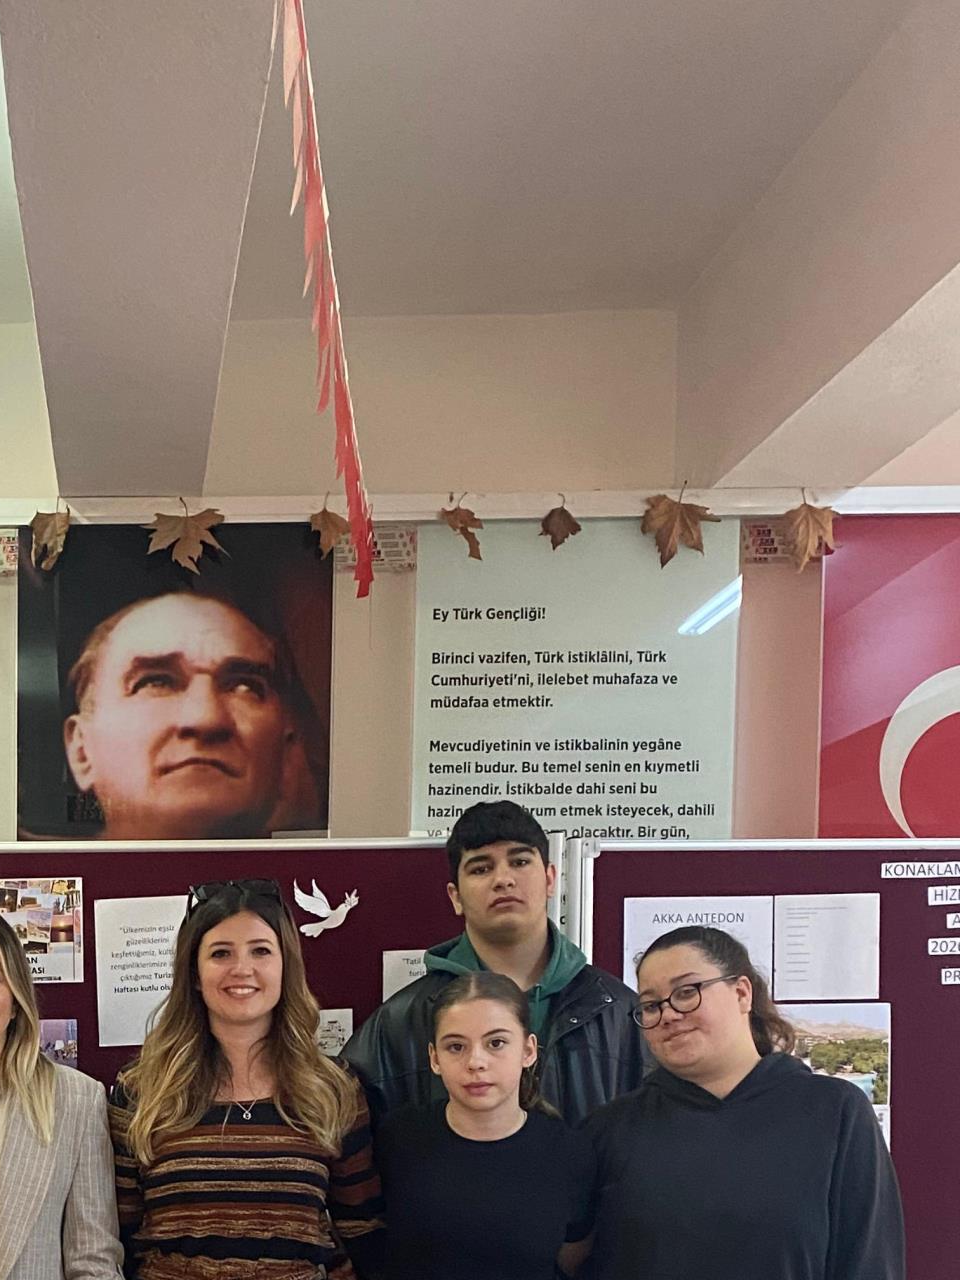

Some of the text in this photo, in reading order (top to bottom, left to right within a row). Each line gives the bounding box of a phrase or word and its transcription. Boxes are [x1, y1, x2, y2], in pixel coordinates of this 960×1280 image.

[433, 607, 546, 622] Ey Türk Gençliği!
[432, 651, 474, 664] Birinci
[478, 651, 531, 666] vazifen,
[534, 651, 564, 664] Türk
[636, 650, 666, 663] Türk
[538, 672, 589, 686] ilelebet
[592, 672, 658, 685] muhafaza
[662, 675, 678, 684] ve
[430, 695, 553, 708] müdafaa etmektir.
[429, 738, 682, 754] Mevcudiyetinin ve istikbalinin yegâne
[428, 760, 699, 774] temeli budur. Bu temel senin en kıymetli
[428, 780, 657, 796] hazinendir. İstikbalde dahi seni bu
[560, 804, 714, 818] etmek isteyecek, dahili
[638, 825, 657, 838] Bir
[660, 826, 690, 840] gün,
[934, 886, 960, 901] HİZ
[652, 912, 744, 924] AKKA ANTEDON
